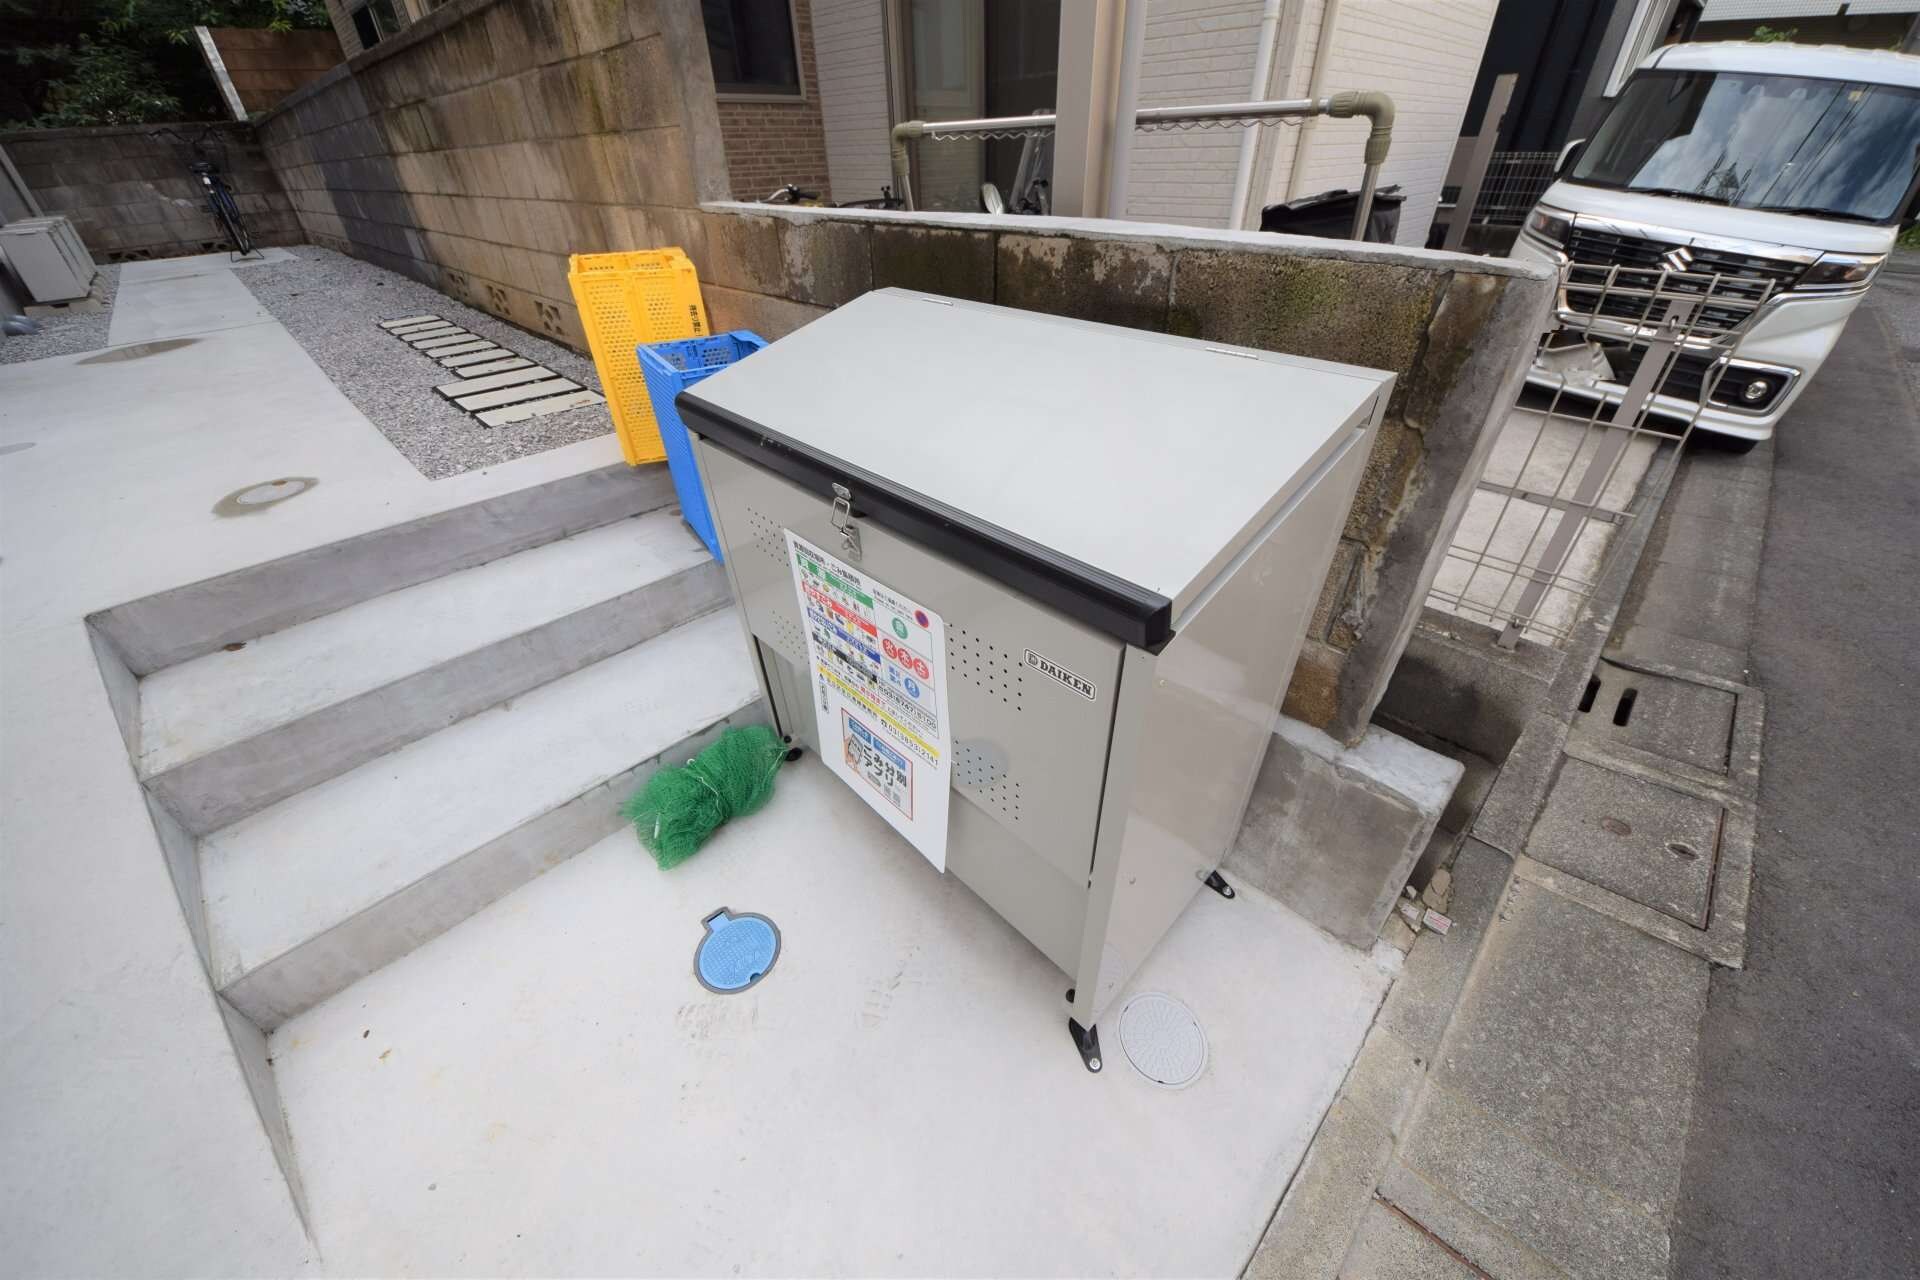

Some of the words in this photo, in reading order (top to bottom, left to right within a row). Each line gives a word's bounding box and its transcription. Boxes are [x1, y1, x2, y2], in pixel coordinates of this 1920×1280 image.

[1040, 660, 1092, 696] DAIKEN
[863, 744, 907, 788] ごみ分別
[863, 755, 894, 787] アプリ
